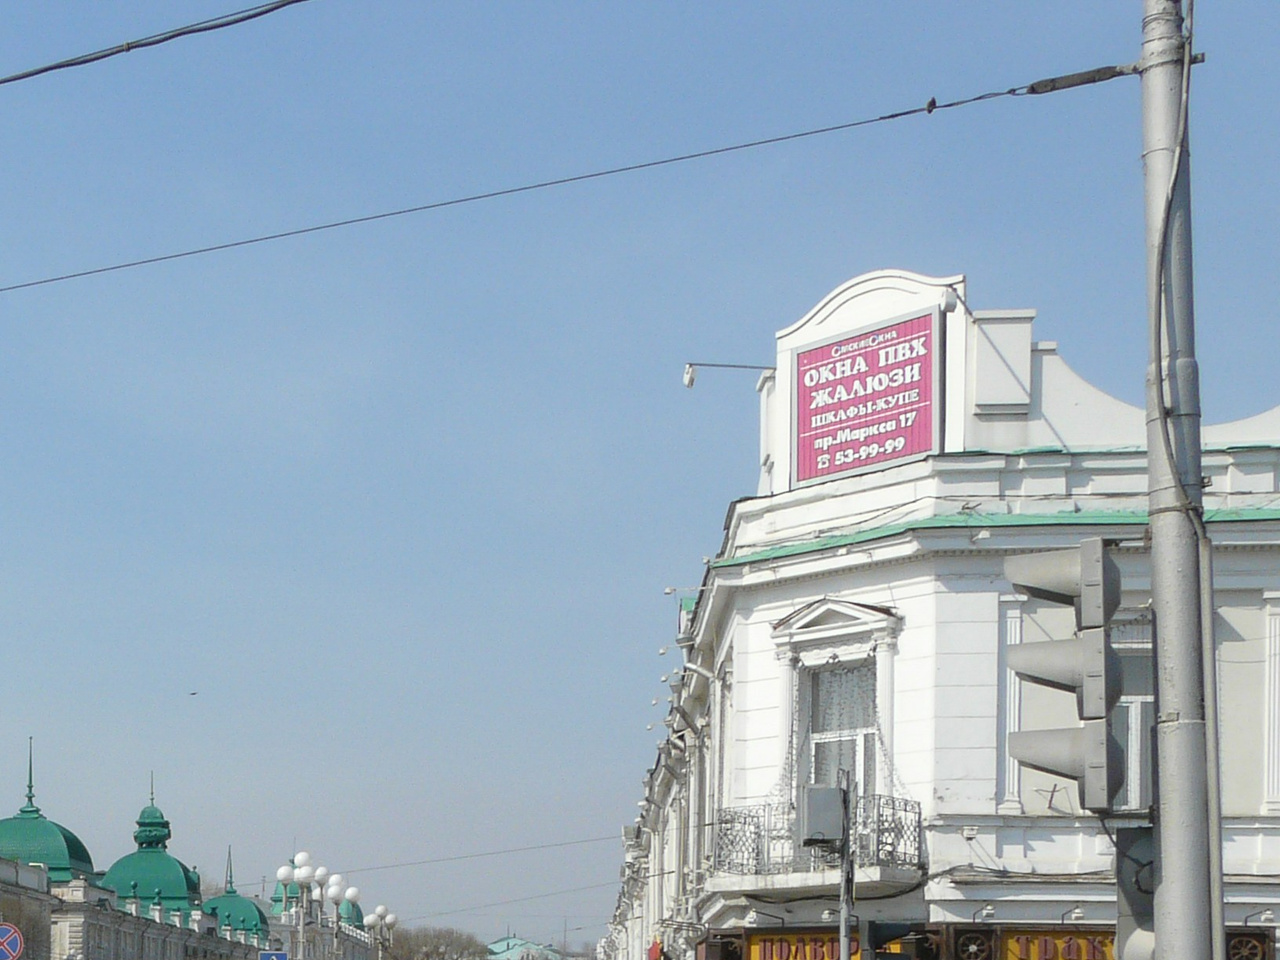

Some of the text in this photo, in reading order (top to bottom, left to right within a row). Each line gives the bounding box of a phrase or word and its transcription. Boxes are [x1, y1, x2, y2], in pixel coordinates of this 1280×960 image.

[804, 337, 928, 387] ОКНА ПВХ
[810, 363, 922, 409] ЖАЛЮЗИ
[811, 389, 919, 428] ШКАФЫ-КУПЕ
[899, 411, 917, 428] 17
[834, 437, 906, 466] 53-99-99
